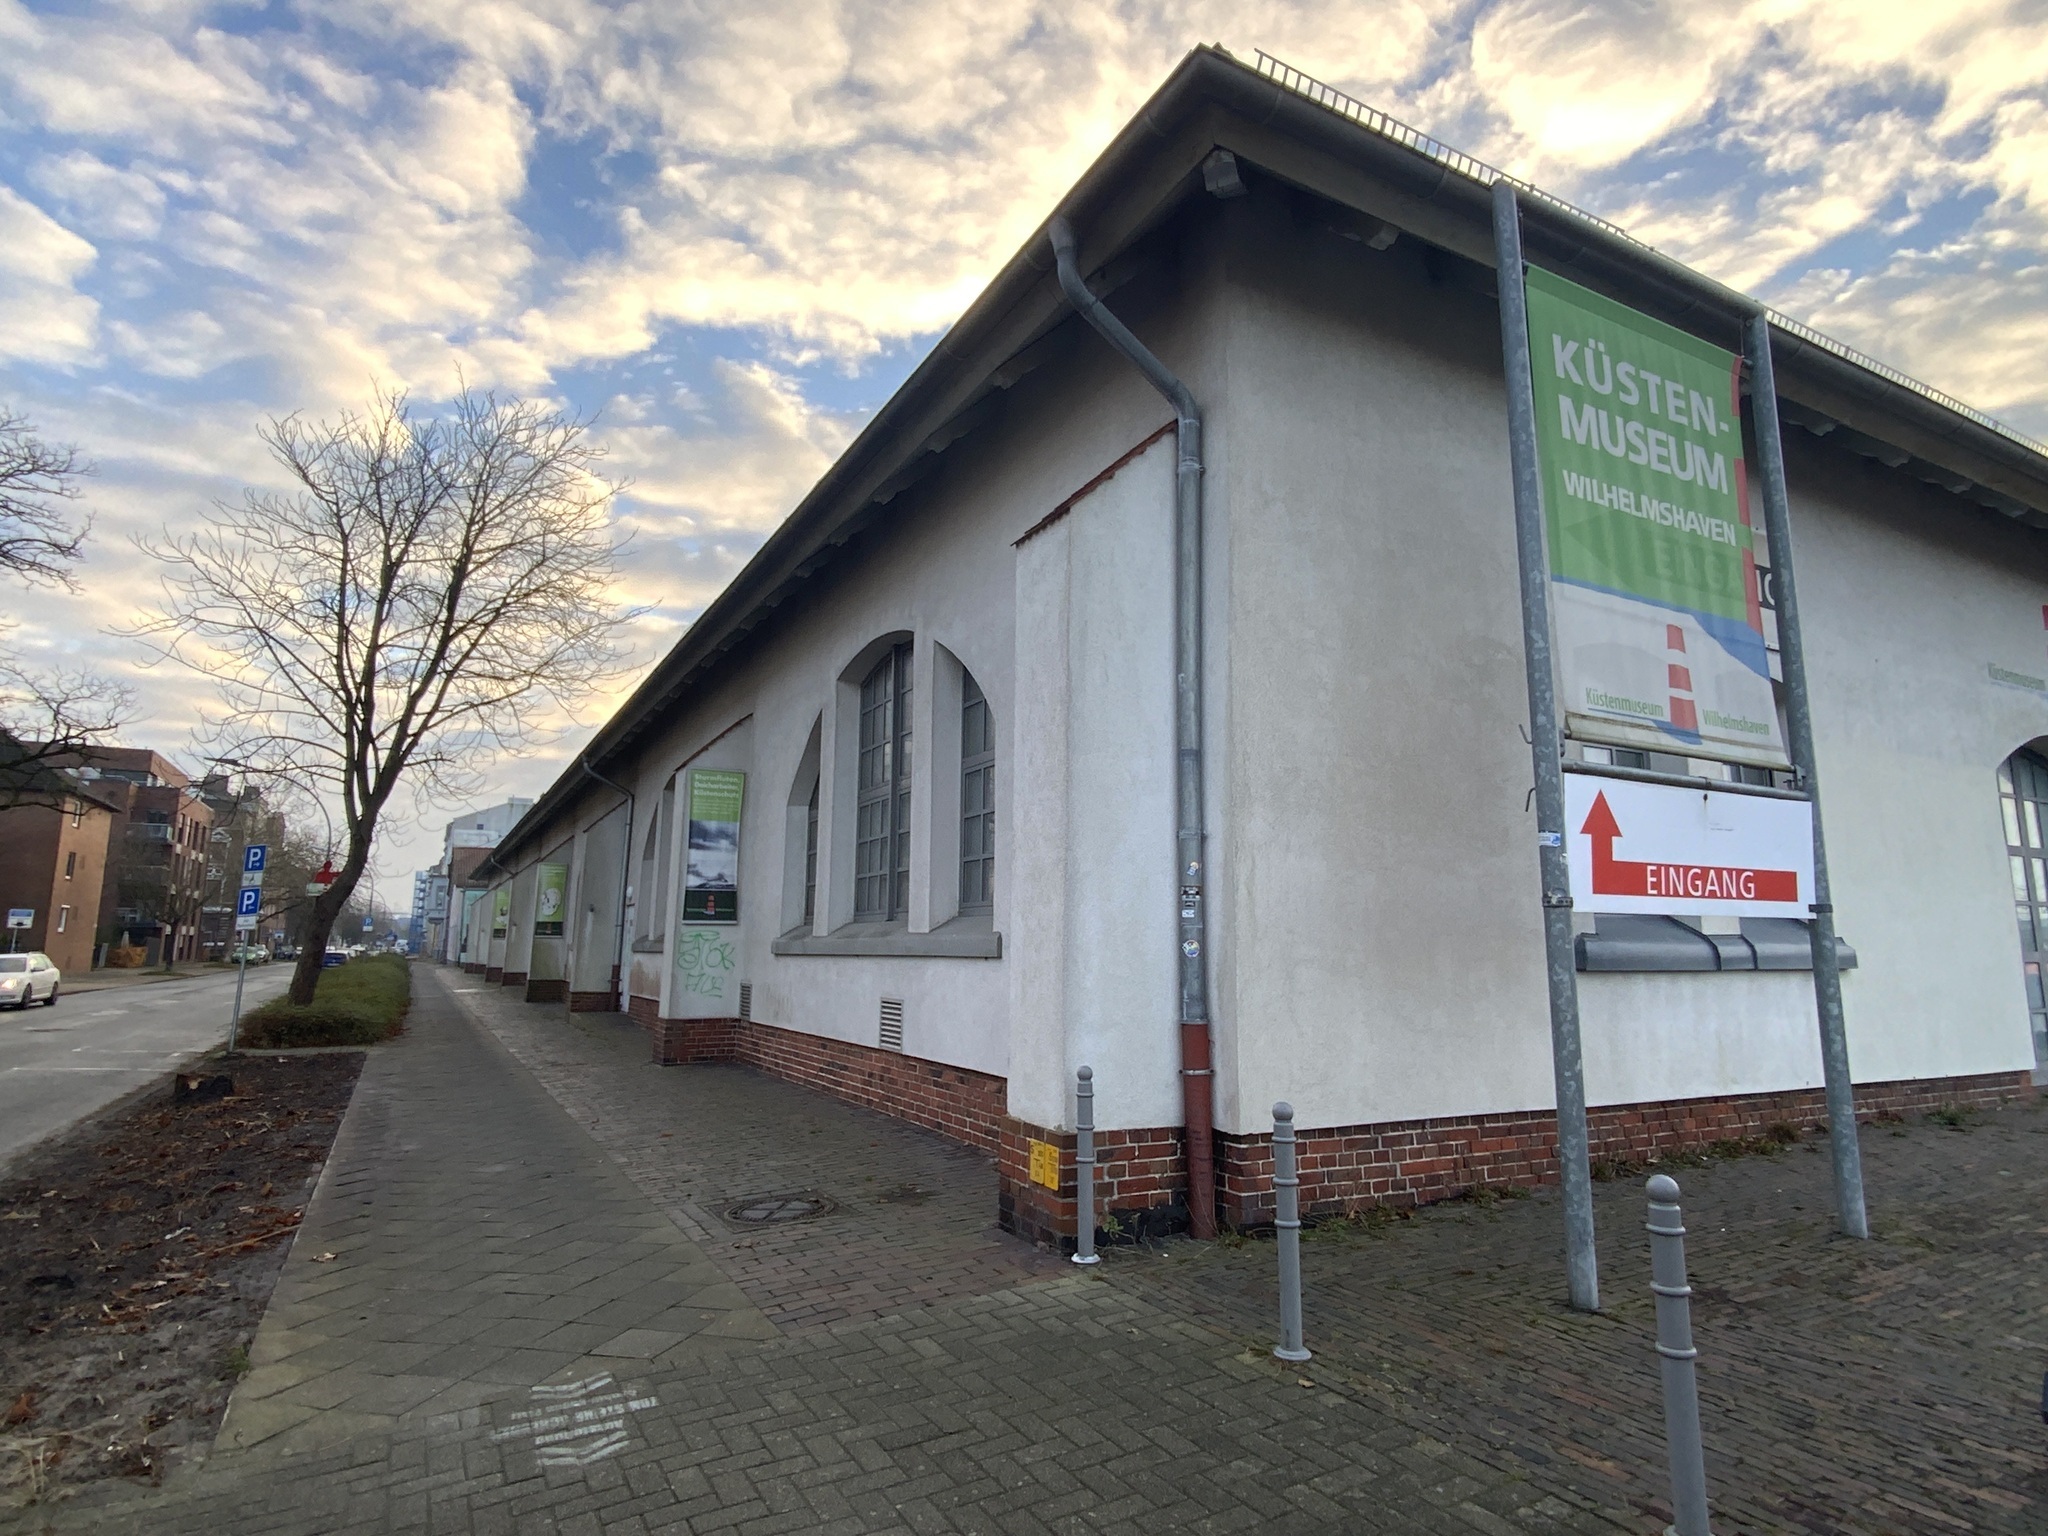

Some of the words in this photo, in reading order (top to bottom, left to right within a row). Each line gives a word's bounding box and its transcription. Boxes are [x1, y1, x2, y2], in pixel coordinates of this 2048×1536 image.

[1552, 333, 1729, 437] KÜSTEN-
[1558, 394, 1728, 495] MUSEUM
[1562, 469, 1736, 547] WILHELMSHAVEN
[1585, 687, 1664, 717] Küstenmuseum
[1702, 709, 1770, 736] Wilhelmshaven
[248, 848, 262, 869] P
[1646, 865, 1756, 899] EINGANG
[242, 891, 256, 912] P
